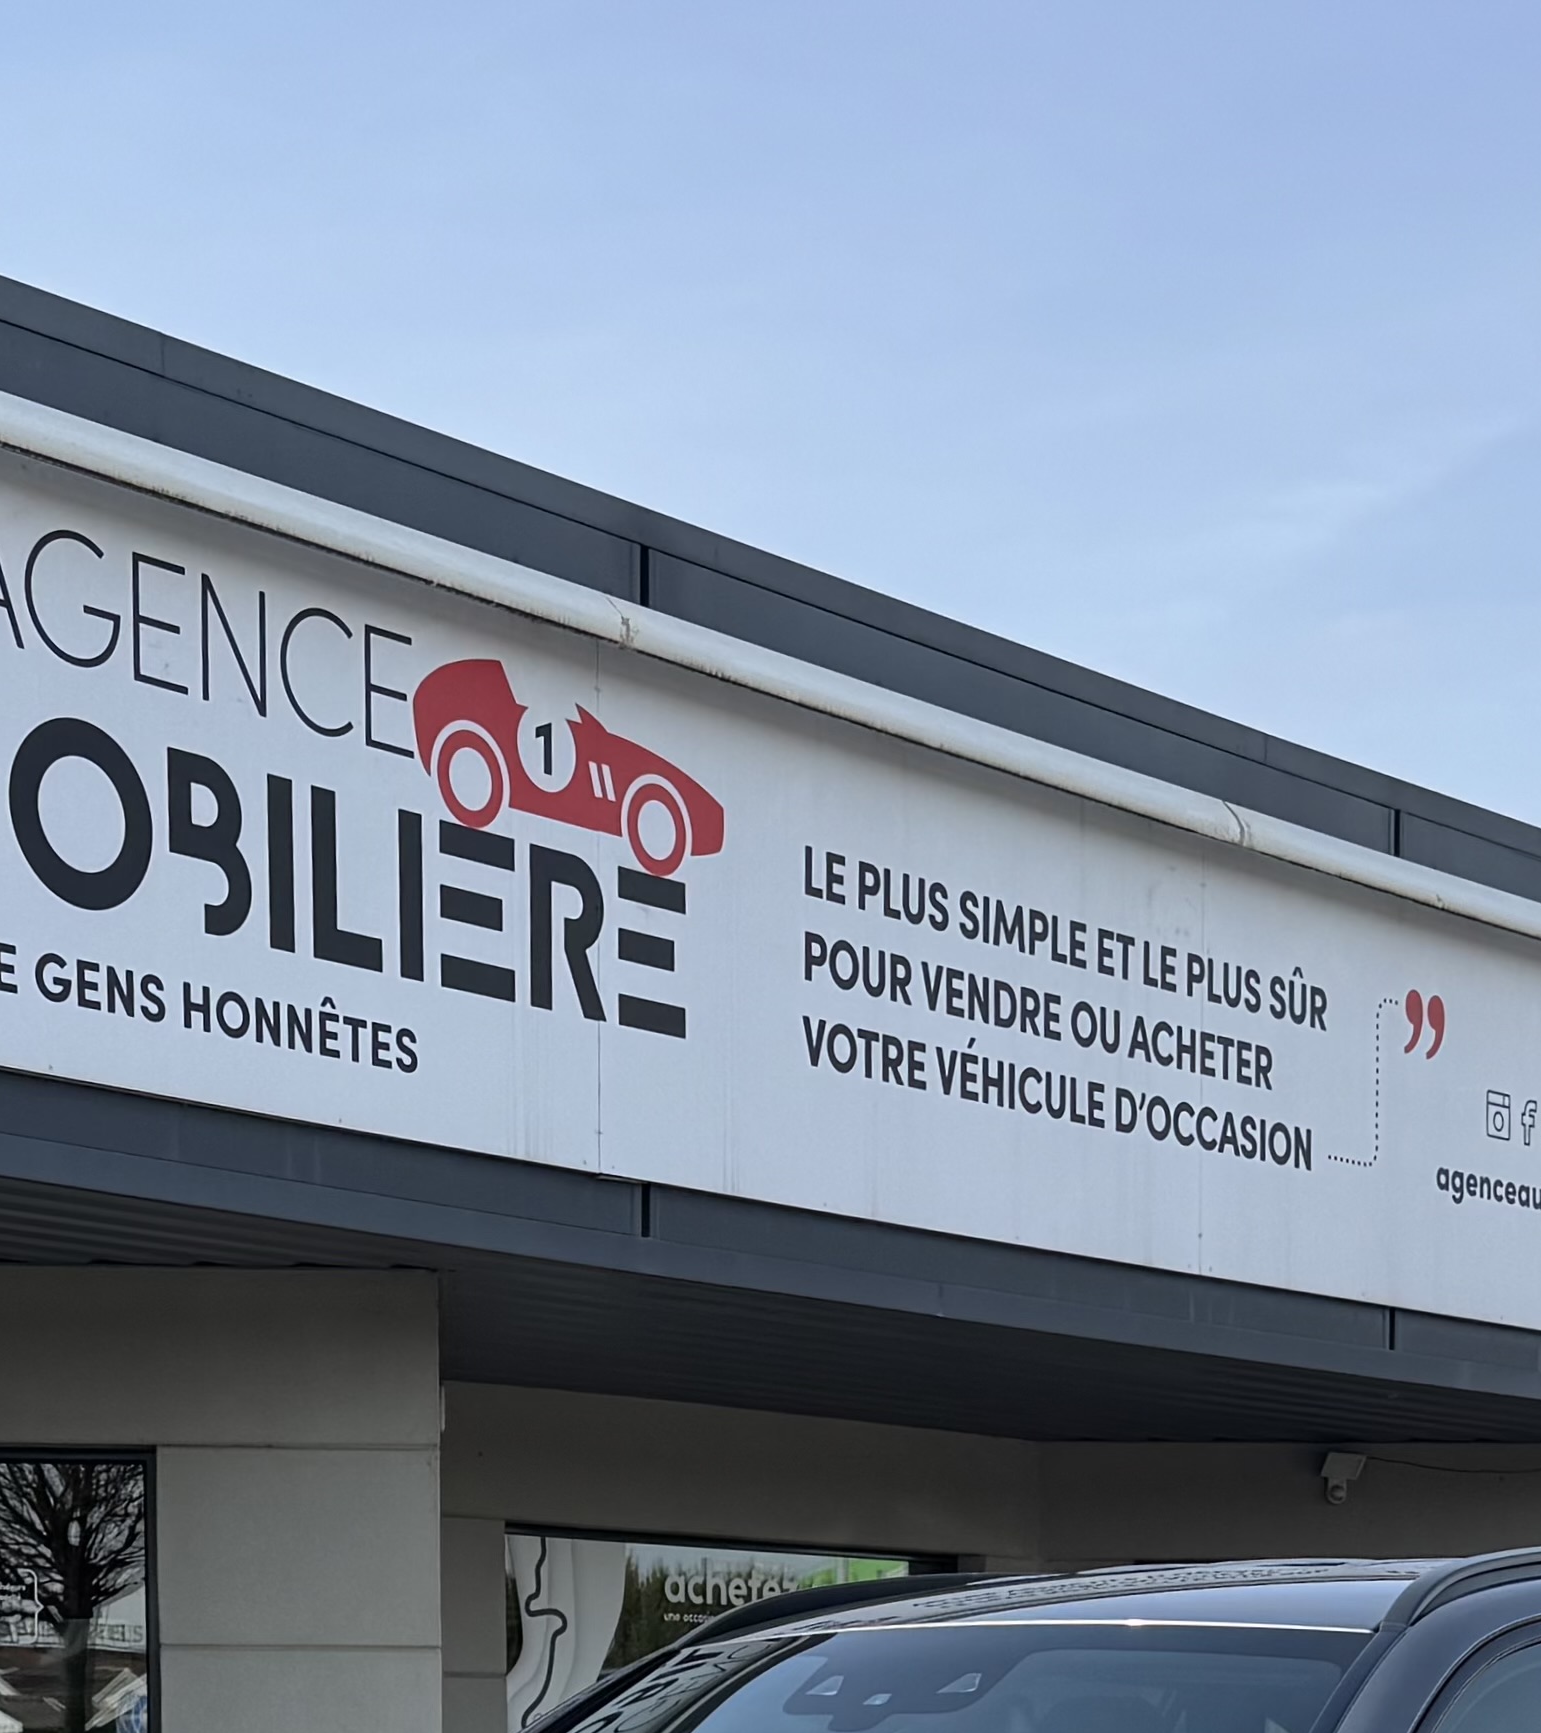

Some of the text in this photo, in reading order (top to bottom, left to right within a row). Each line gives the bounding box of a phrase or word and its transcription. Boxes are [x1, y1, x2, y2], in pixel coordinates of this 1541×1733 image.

[35, 954, 166, 1023] GENS
[182, 985, 419, 1074] HONNÊTES
[804, 845, 1329, 1031] LE PLUS SIMPLE ET LE PLUS SÛR
[804, 931, 1274, 1090] POUR VENDRE OU ACHETER
[802, 1016, 1313, 1171] VOTRE VÉHICULE D'OCCASION
